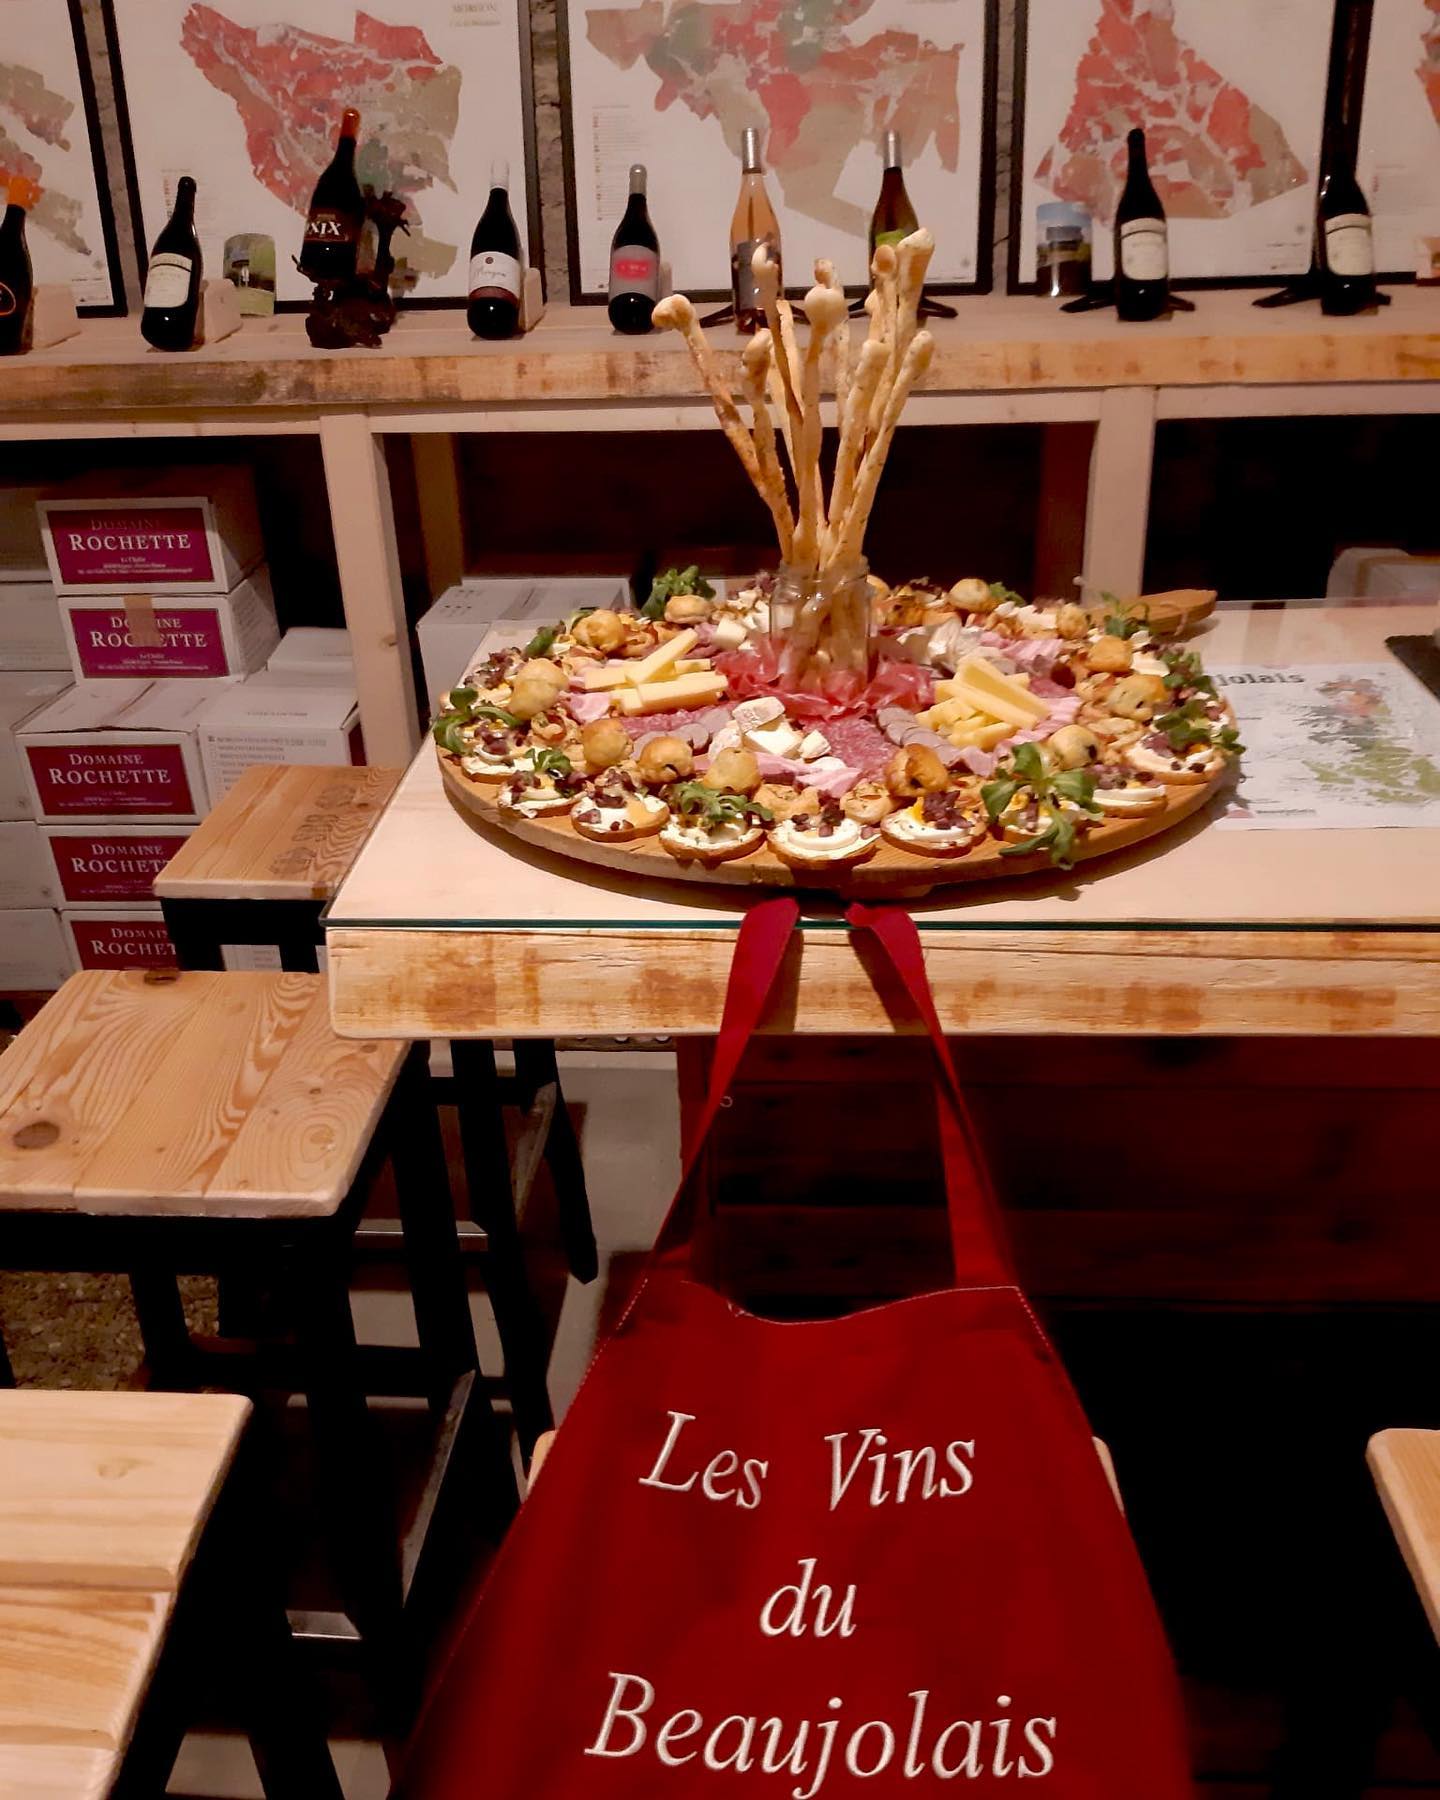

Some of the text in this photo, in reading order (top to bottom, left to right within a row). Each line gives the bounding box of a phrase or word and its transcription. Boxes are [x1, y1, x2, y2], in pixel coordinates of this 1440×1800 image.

[69, 534, 191, 551] ROCHETTE
[111, 616, 182, 629] DOINE
[90, 631, 207, 648] ROCETTE
[1216, 672, 1306, 687] jolais
[69, 753, 144, 766] DOMAINE
[49, 768, 172, 785] ROCHETTE
[92, 844, 164, 856] DOMAINE
[71, 857, 171, 873] ROCHET
[90, 940, 177, 956] ROCHET
[638, 1410, 975, 1512] Les Vins
[759, 1558, 857, 1638] du
[584, 1672, 1057, 1800] Beaujolais
